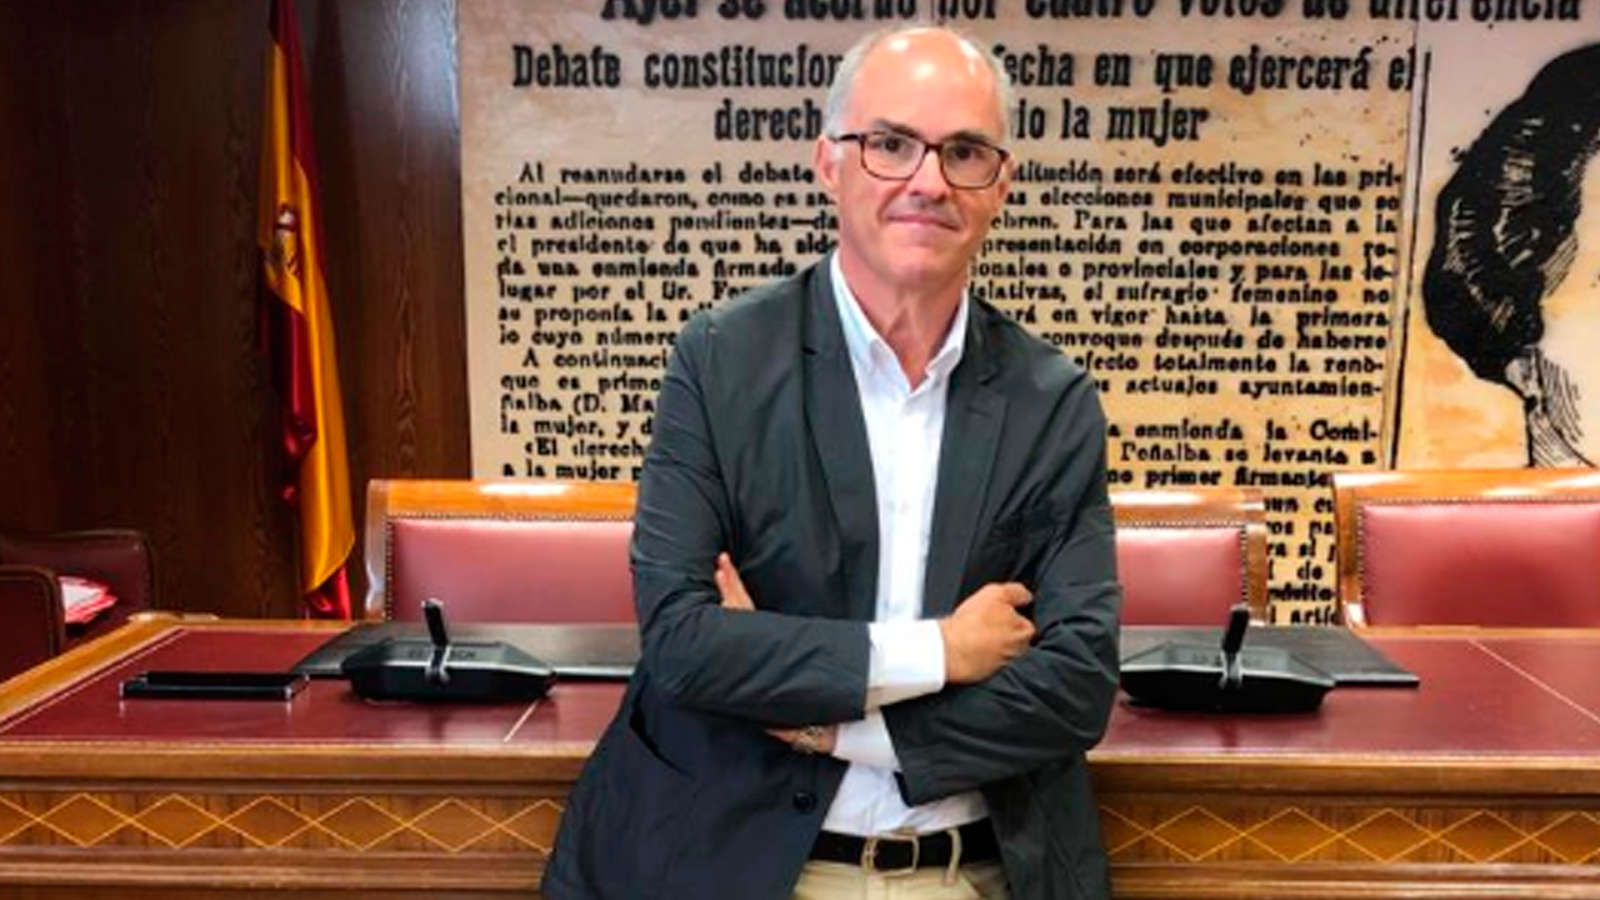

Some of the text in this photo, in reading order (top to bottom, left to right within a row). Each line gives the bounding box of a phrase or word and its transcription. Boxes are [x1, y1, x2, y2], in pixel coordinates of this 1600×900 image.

[512, 44, 621, 87] Debate
[1094, 53, 1132, 86] en
[1154, 53, 1213, 93] que
[1228, 45, 1374, 95] ejercerá
[1388, 45, 1416, 91] el
[714, 98, 822, 140] derech
[1061, 98, 1091, 139] la
[1105, 98, 1210, 147] mujer
[518, 161, 815, 184] Al reanudarse el debate
[1113, 162, 1162, 184] será
[1171, 162, 1264, 185] efectivo
[1275, 168, 1303, 186] en
[1313, 162, 1348, 187] las
[707, 192, 765, 206] como
[1040, 186, 1155, 206] elecciones
[1168, 187, 1308, 213] municipales
[1318, 195, 1362, 214] que
[1074, 210, 1128, 230] Para
[1141, 210, 1174, 231] las
[1190, 216, 1232, 235] que
[1246, 213, 1333, 234] afectan
[1345, 218, 1360, 233] a
[1375, 213, 1397, 234] la
[531, 233, 650, 258] presidente
[663, 235, 690, 254] de
[701, 239, 741, 258] que
[754, 232, 783, 254] ha
[1138, 239, 1165, 254] en
[1179, 235, 1341, 260] corporaciones
[537, 261, 580, 277] una
[592, 257, 700, 278] enmienda
[1058, 263, 1072, 277] o
[1083, 257, 1219, 281] provinciales
[1229, 264, 1245, 284] y
[1254, 263, 1310, 284] para
[1319, 259, 1354, 282] las
[500, 280, 557, 302] lugar
[573, 285, 611, 303] por
[625, 281, 646, 300] el
[1083, 281, 1104, 301] el
[1116, 281, 1209, 305] sufragio
[1230, 283, 1339, 304] femenino
[1362, 288, 1391, 304] no
[646, 302, 668, 323] la
[1051, 309, 1079, 324] en
[1090, 303, 1149, 327] vigor
[1164, 305, 1228, 326] hasta
[1249, 305, 1272, 328] la
[1295, 306, 1390, 330] primera
[531, 329, 584, 349] cuyo
[1154, 328, 1245, 351] después
[1256, 329, 1286, 350] de
[1296, 328, 1388, 350] haberse
[521, 348, 669, 369] A continuaci
[1153, 351, 1277, 373] totalmente
[1289, 351, 1310, 373] la
[500, 371, 662, 396] que es prime
[1125, 374, 1218, 396] actuales
[619, 393, 655, 413] Ma
[501, 413, 521, 435] la
[532, 415, 605, 438] mujer,
[616, 420, 630, 439] y
[1134, 417, 1244, 440] enmienda
[1265, 418, 1289, 441] la
[571, 438, 644, 457] derech
[1224, 448, 1249, 462] se
[1262, 442, 1349, 465] levanta
[1360, 450, 1376, 465] a
[502, 462, 517, 477] a
[525, 458, 547, 477] la
[555, 459, 622, 481] mujer
[1144, 464, 1222, 489] primer
